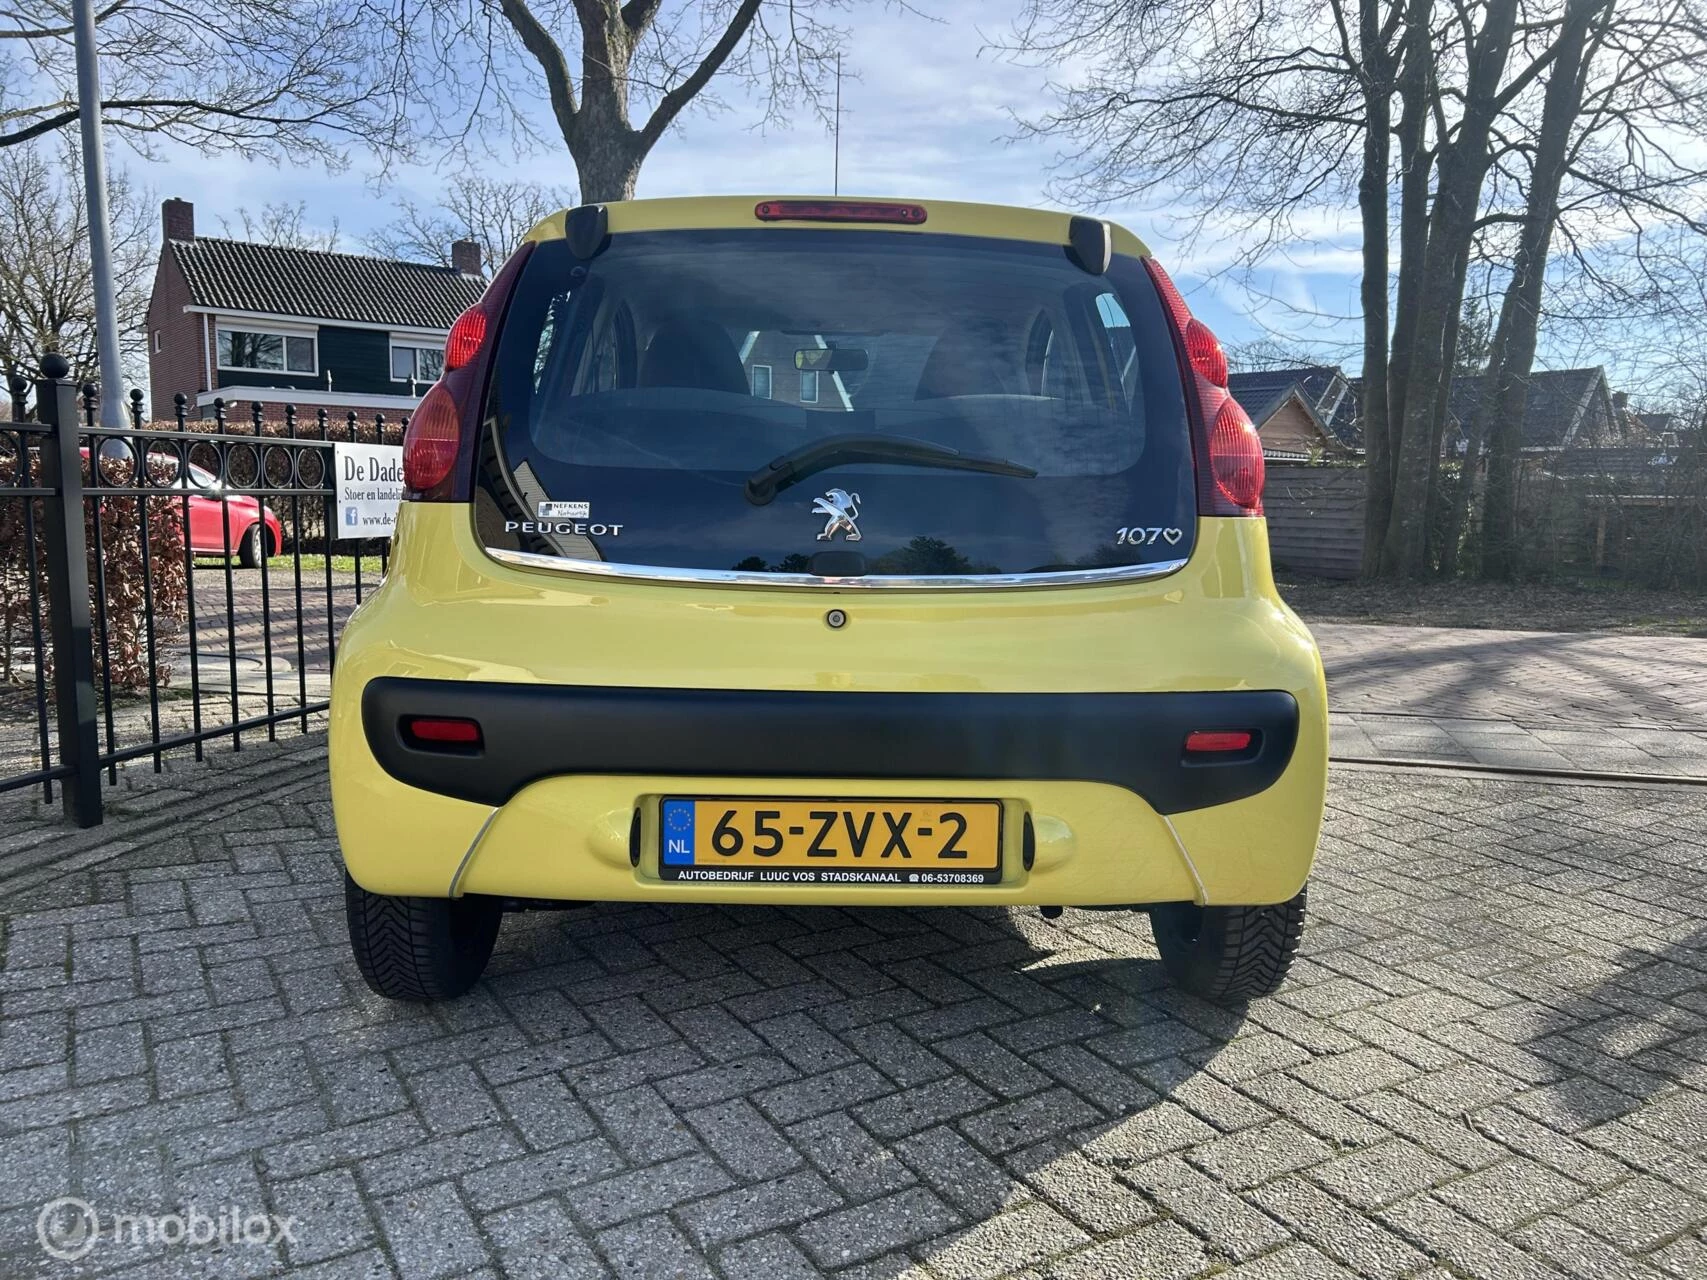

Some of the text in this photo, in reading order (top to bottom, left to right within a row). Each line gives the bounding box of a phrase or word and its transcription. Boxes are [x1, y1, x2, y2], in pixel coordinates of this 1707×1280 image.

[344, 455, 365, 482] De
[344, 486, 365, 501] Stoer
[366, 490, 376, 500] en
[504, 521, 624, 536] PEUGEOT
[1116, 527, 1163, 545] 107
[711, 809, 969, 860] 65-ZVX-2
[667, 839, 691, 854] NL
[678, 870, 984, 883] AUTOBEDRIJF LUUC VOS STADSKANAAL 06-53708369
